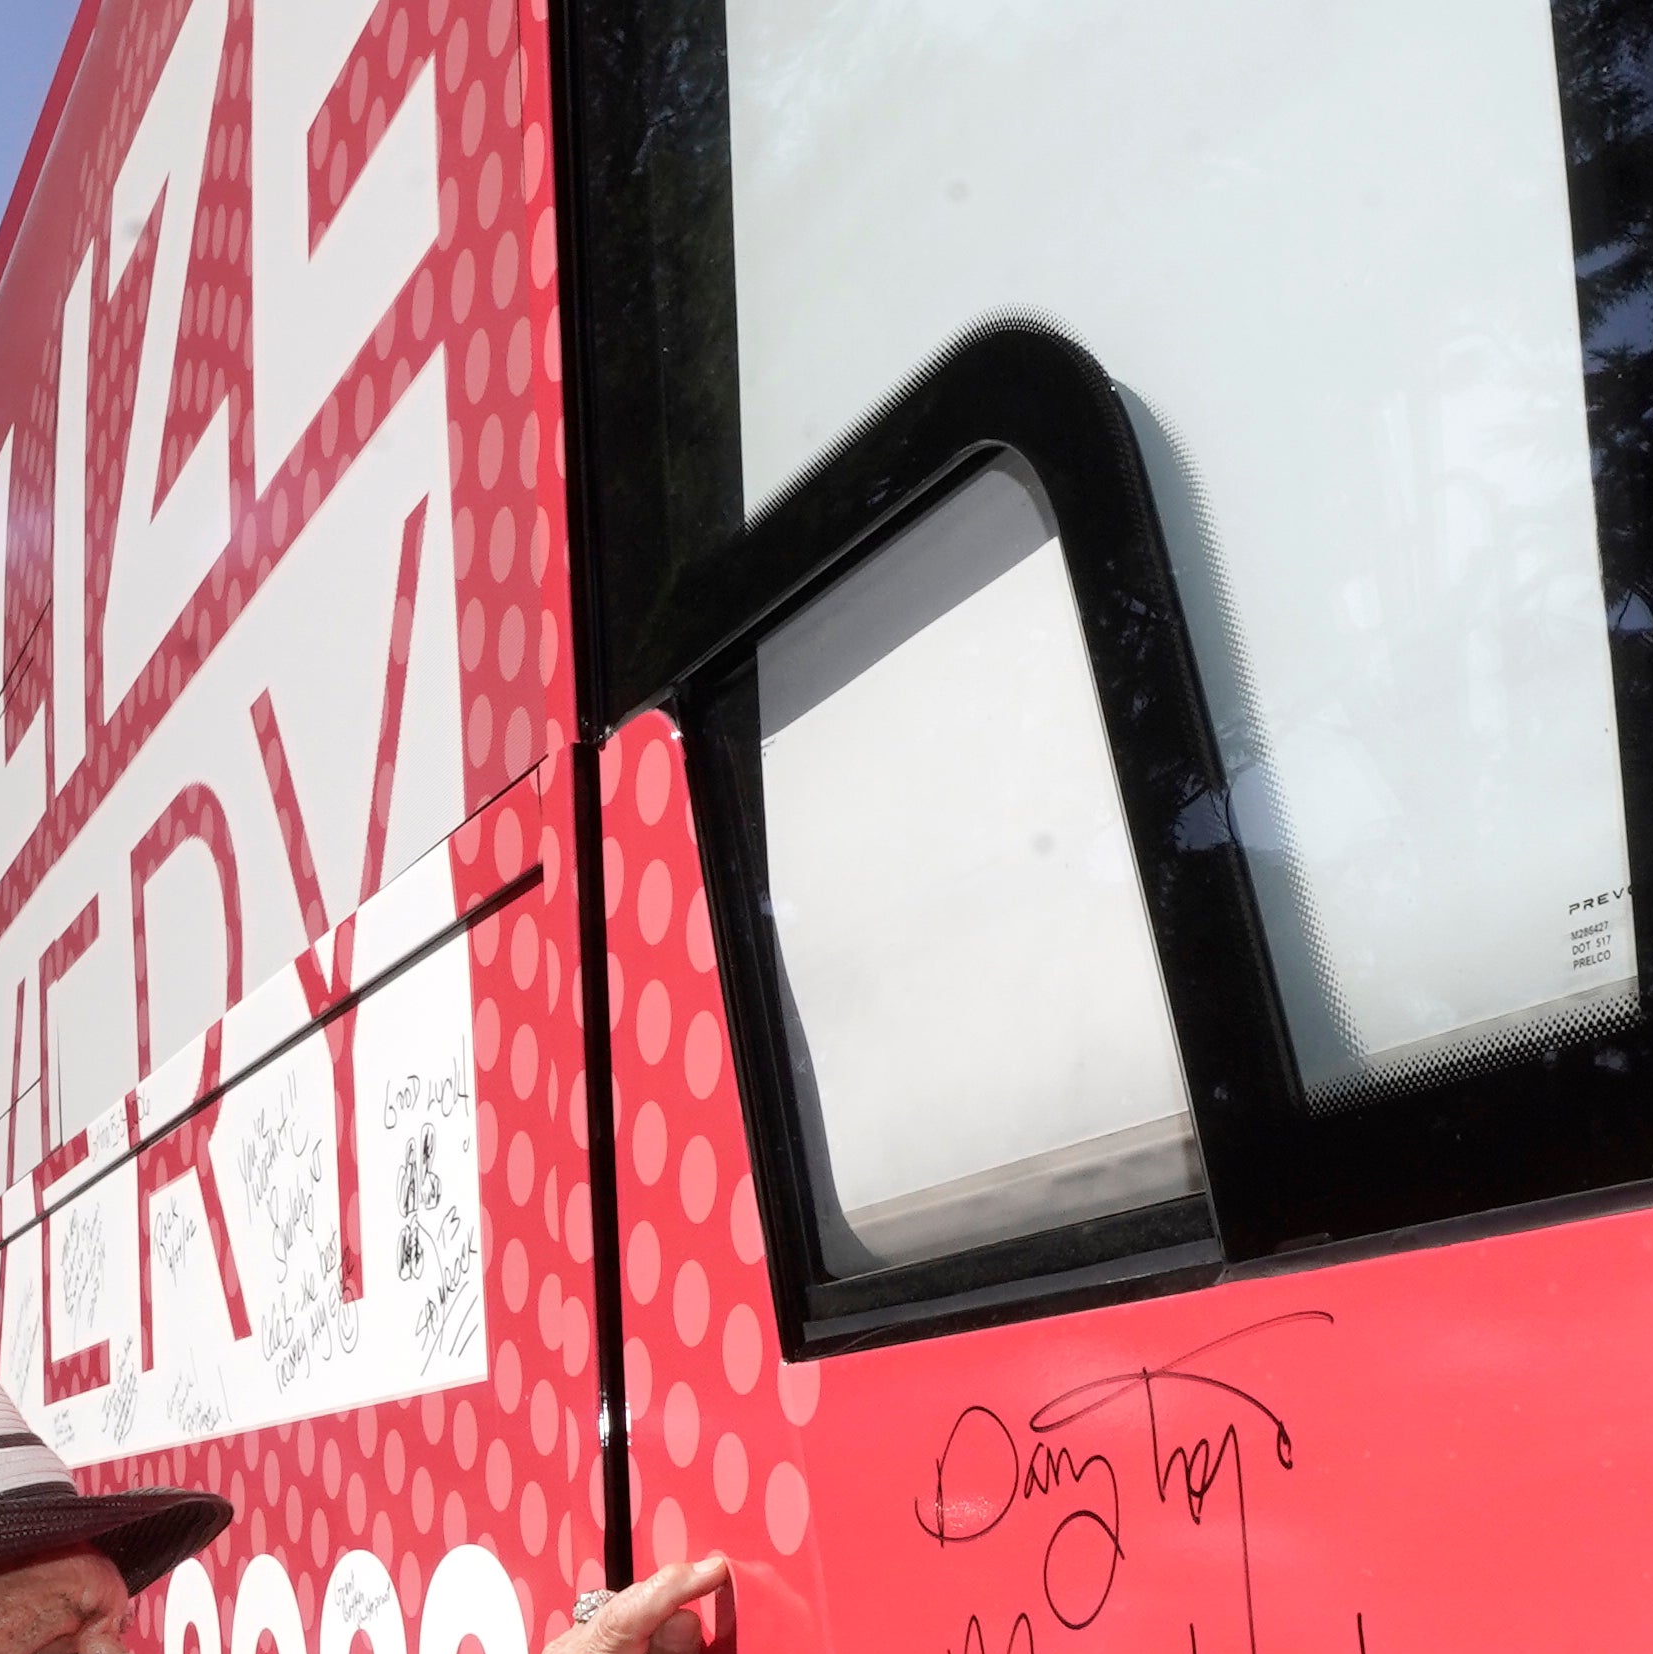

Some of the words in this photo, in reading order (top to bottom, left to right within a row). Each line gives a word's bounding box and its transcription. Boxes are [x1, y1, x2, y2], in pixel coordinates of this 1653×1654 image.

[1572, 942, 1591, 956] DOT
[1573, 950, 1611, 970] PRELCO
[384, 1075, 420, 1129] GOOD
